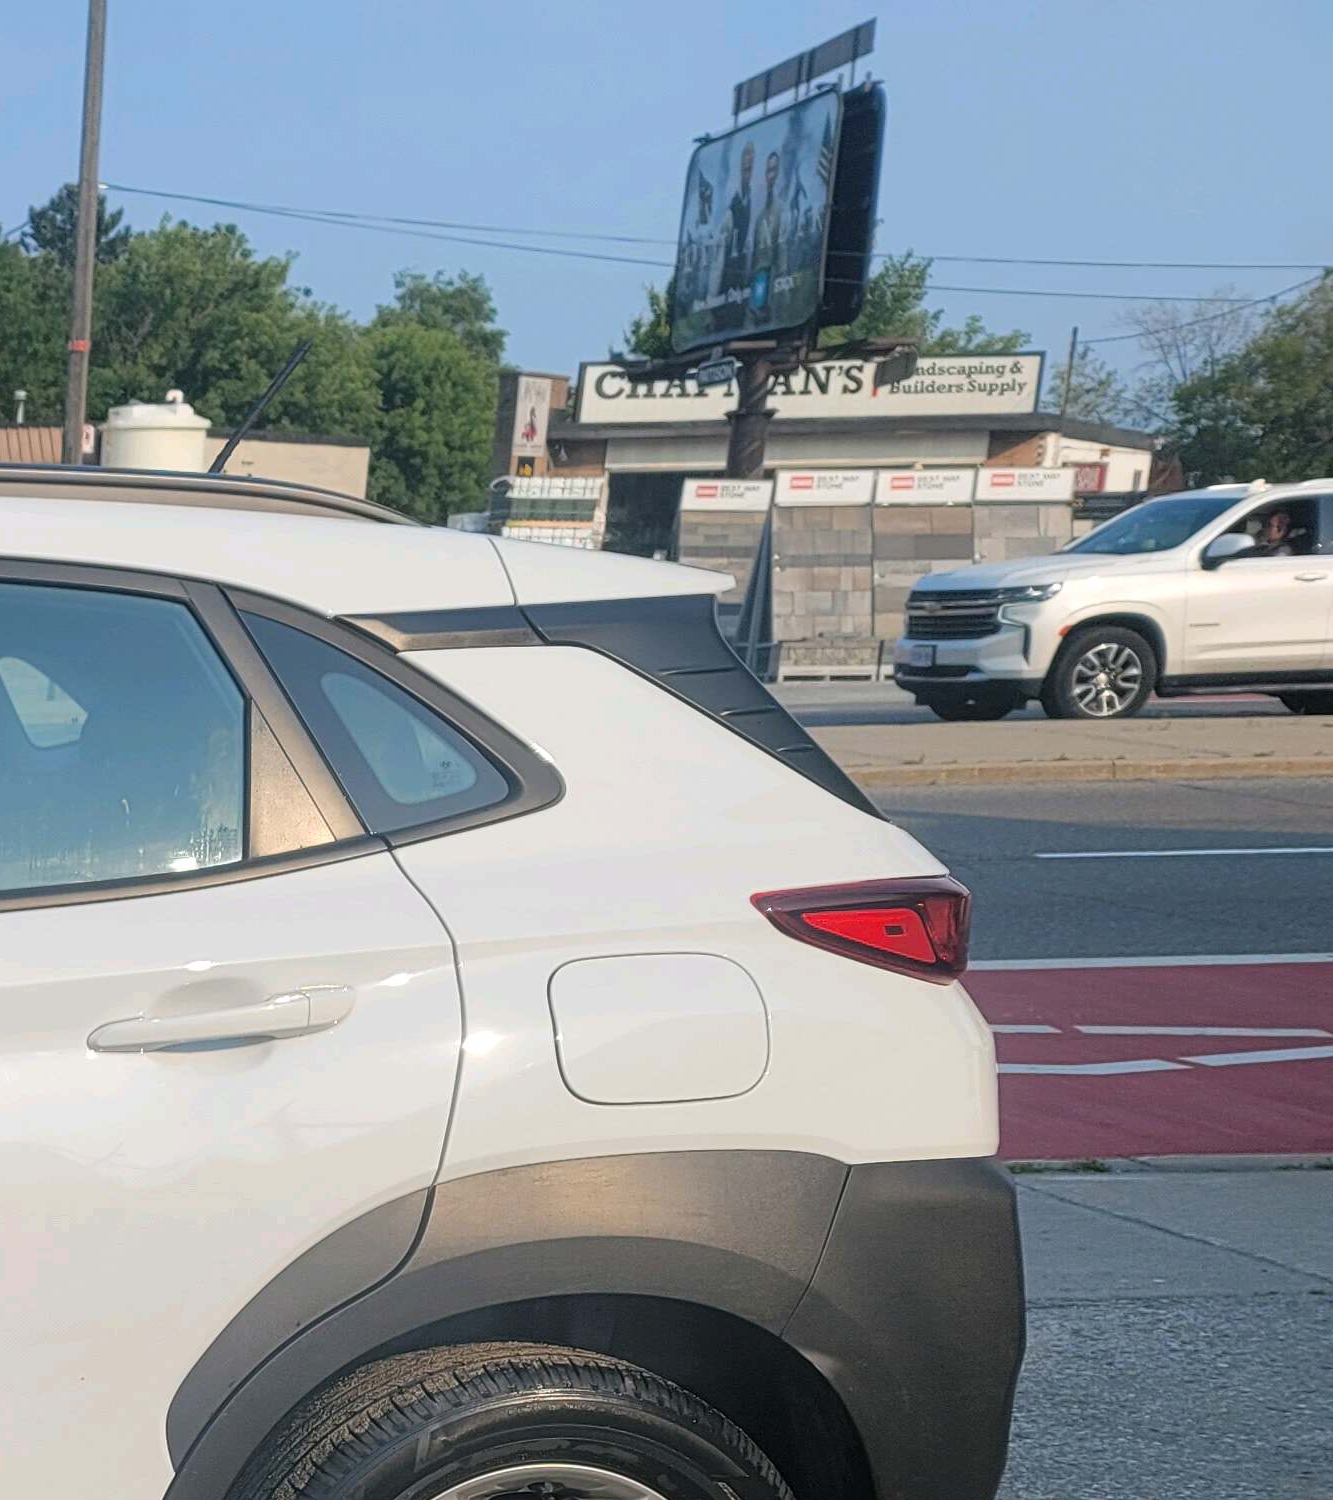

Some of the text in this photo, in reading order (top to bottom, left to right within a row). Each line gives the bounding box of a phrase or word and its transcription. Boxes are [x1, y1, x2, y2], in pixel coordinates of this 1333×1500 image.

[914, 361, 1024, 378] ndscaping &
[889, 378, 1028, 396] Builders Supply
